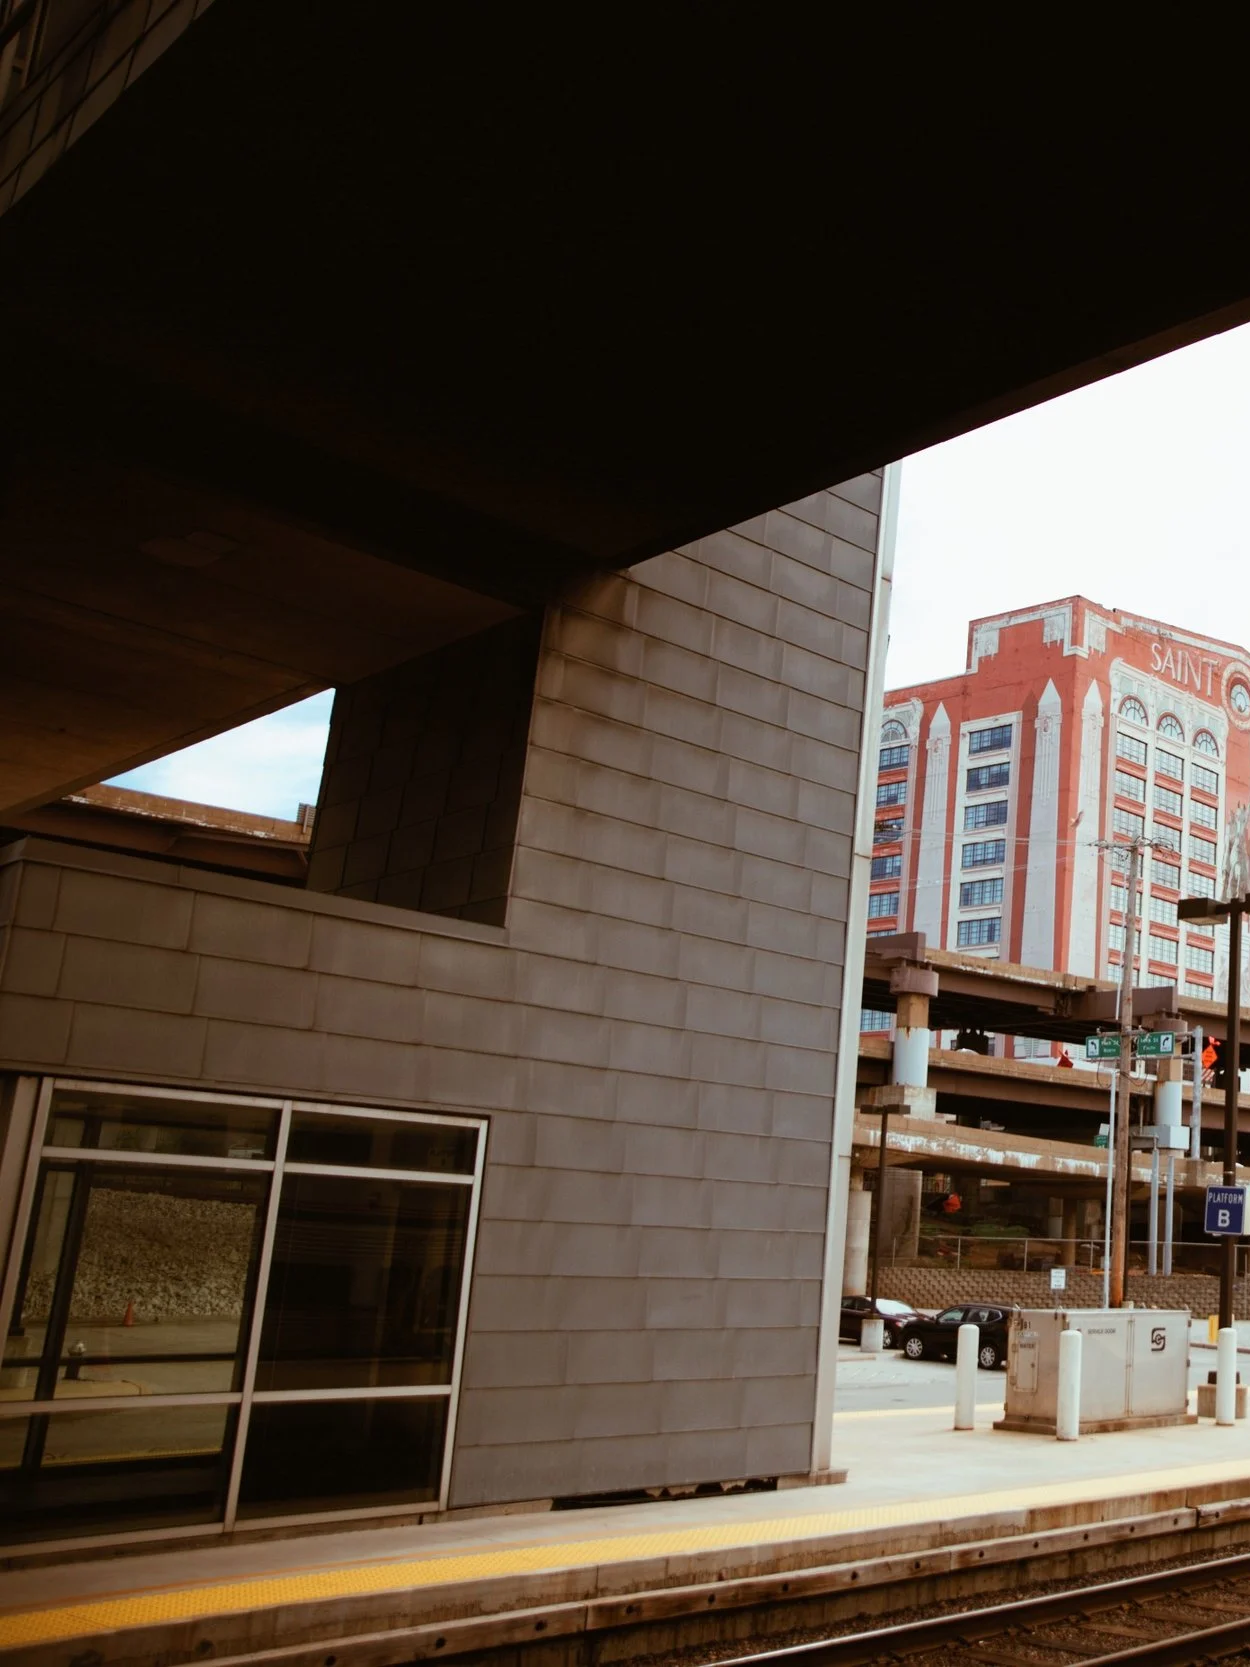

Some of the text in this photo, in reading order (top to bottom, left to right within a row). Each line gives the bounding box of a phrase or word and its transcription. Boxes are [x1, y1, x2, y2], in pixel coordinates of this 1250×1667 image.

[1150, 642, 1219, 697] SAINT
[1208, 1192, 1243, 1204] PLATFORM
[1217, 1209, 1230, 1227] B
